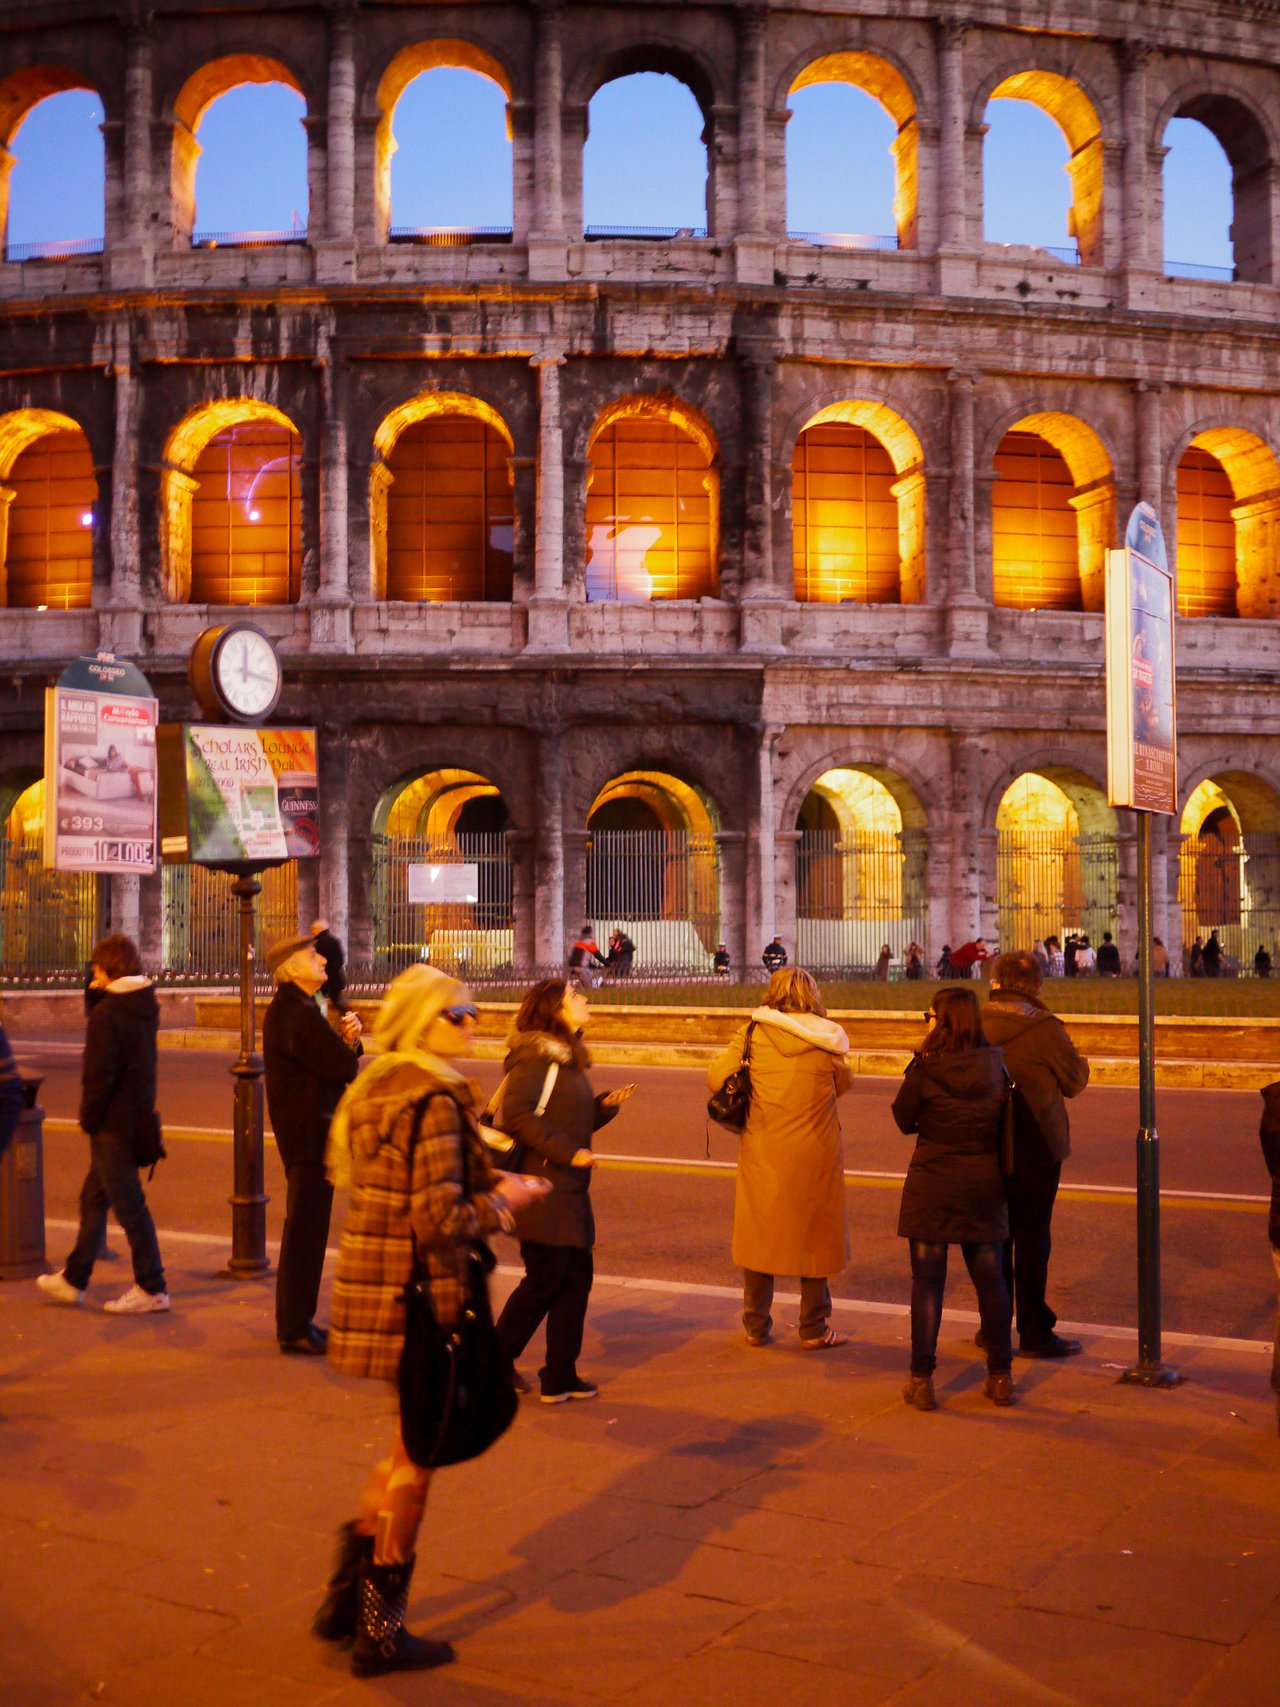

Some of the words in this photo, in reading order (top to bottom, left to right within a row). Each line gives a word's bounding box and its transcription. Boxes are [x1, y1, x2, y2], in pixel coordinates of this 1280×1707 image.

[88, 664, 125, 677] COLOSSEO
[281, 799, 319, 813] GUINNESS
[71, 816, 104, 832] 393
[61, 846, 94, 857] PRODOTTO
